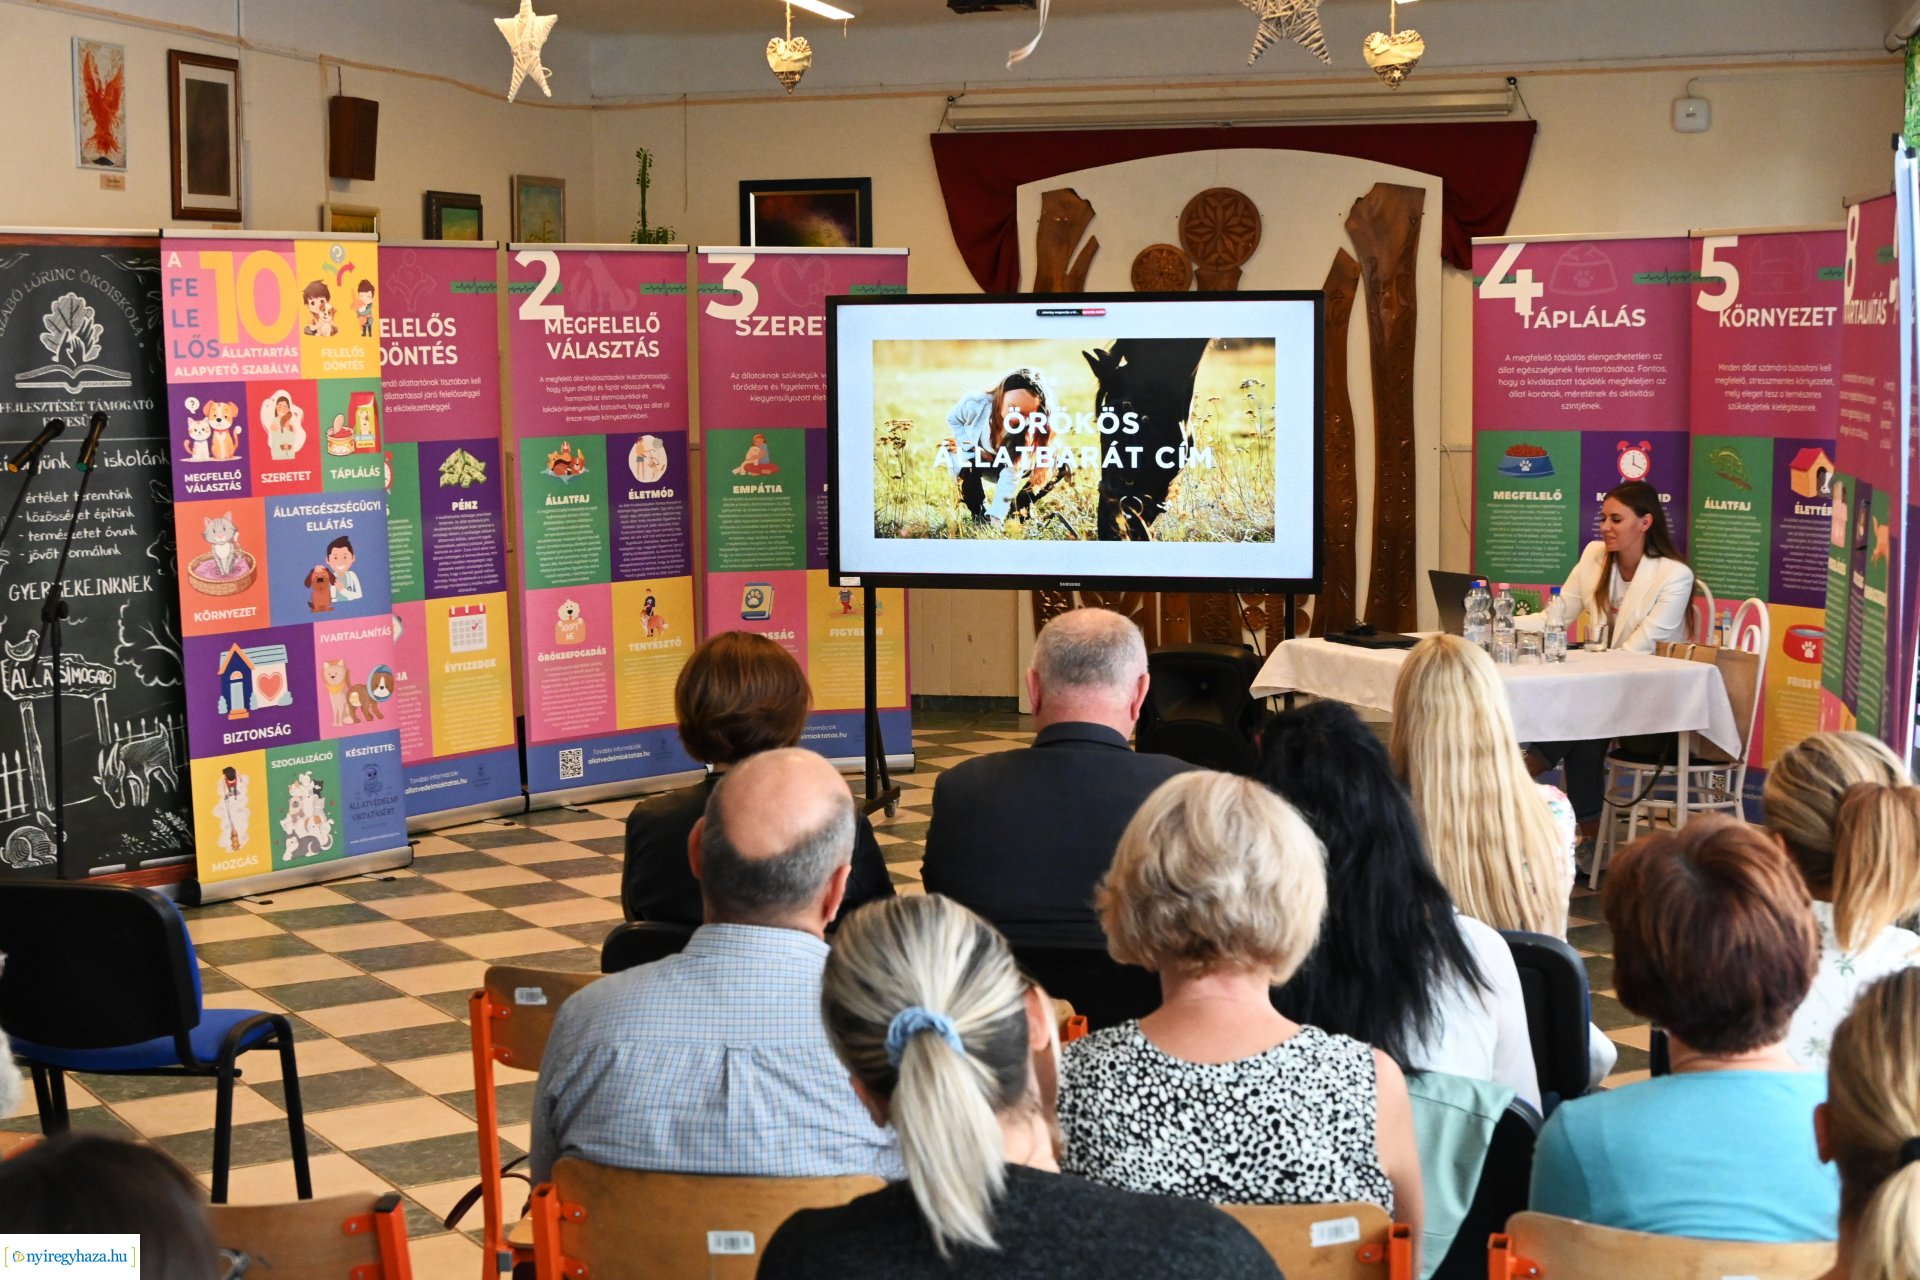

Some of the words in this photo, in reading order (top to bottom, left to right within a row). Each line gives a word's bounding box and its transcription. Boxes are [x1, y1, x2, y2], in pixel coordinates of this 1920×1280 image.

[167, 252, 182, 268] A
[1479, 243, 1543, 315] 4
[1696, 236, 1740, 312] 5
[514, 250, 565, 320] 2
[705, 254, 759, 320] 3
[199, 249, 299, 345] 10
[544, 312, 661, 335] MEGFELELŐ
[1519, 305, 1647, 329] TÁPLÁLÁS
[1719, 304, 1837, 328] KÖRNYEZET
[379, 313, 457, 338] ELELŐS
[735, 316, 827, 337] SZERE
[222, 346, 299, 360] ÁLLATTARTÁS
[546, 336, 660, 360] VÁLASZTÁS
[1513, 354, 1552, 363] megfelelő
[1554, 353, 1585, 362] táplálás
[1587, 352, 1651, 363] elengedhetetlen
[174, 363, 240, 378] ALAPVETŐ
[242, 362, 299, 376] SZABÁLYA
[741, 371, 779, 380] állatoknak
[781, 371, 819, 381] szükségük
[1498, 366, 1515, 374] állat
[1517, 366, 1573, 376] egészségének
[1638, 364, 1668, 374] Fontos,
[733, 383, 769, 391] törődésre
[770, 383, 779, 391] és
[1498, 378, 1518, 388] hogy
[1527, 378, 1573, 386] kiválasztott
[1574, 378, 1606, 387] táplálék
[1608, 377, 1655, 387] megfeleljen
[750, 394, 811, 403] kiegyensúlyozott
[812, 393, 827, 401] élet
[1509, 390, 1526, 398] állat
[1564, 389, 1608, 398] méretének
[1619, 389, 1655, 398] aktivitási
[87, 398, 154, 412] TÁMOGATÓ
[1003, 406, 1140, 435] ÖRÖKÖS
[103, 449, 170, 469] iskolánk
[932, 440, 1144, 469] ÁLLATBARÁT
[1154, 440, 1213, 469] CÍM
[184, 469, 242, 483] MEGFELELŐ
[260, 470, 312, 484] SZERETET
[330, 466, 381, 480] TÁPLÁLÁS
[186, 481, 242, 494] VÁLASZTÁS
[628, 486, 674, 500] ÉLETMÓD
[732, 482, 783, 495] EMPÁTIA
[1493, 488, 1563, 501] MEGFELELŐ
[25, 491, 69, 504] értéket
[451, 498, 479, 511] PÉNZ
[545, 493, 590, 506] ÁLLATFAJ
[1704, 496, 1751, 512] ÁLLATFAJ
[273, 499, 381, 518] ÁLLATEGÉSZSÉGÜGYI
[105, 524, 138, 537] óvunk
[306, 518, 354, 532] ELLÁTÁS
[66, 543, 122, 559] ormálunk
[193, 606, 257, 623] KÖRNYEZET
[319, 624, 392, 644] IVARTALANÍTÁS
[537, 645, 607, 663] ÖRÖKBEFOGADÁS
[223, 723, 292, 745] BIZTONSÁG
[345, 743, 396, 759] KÉSZÍTETTE:
[270, 752, 334, 769] SZOCIALIZÁCIÓ
[210, 854, 259, 873] MOZGÁS
